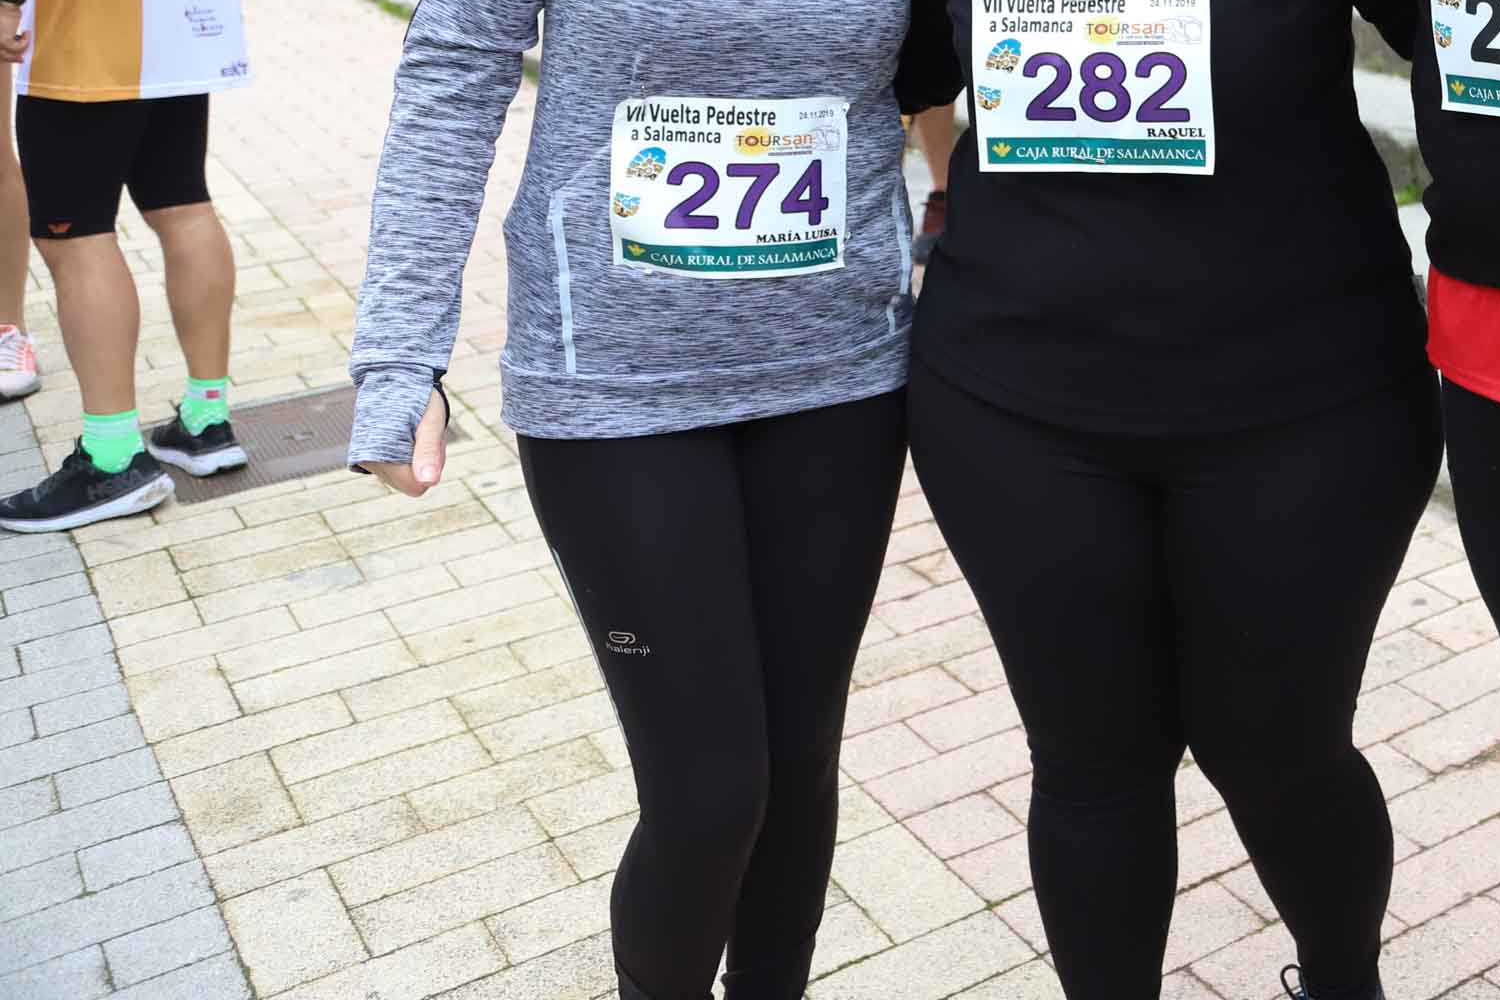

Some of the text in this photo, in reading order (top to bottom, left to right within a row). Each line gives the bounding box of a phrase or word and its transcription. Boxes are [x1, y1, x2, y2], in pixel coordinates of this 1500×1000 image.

[989, 17, 1073, 33] a Salamanca
[1022, 52, 1191, 123] 282
[1468, 86, 1494, 100] CAJA
[650, 103, 700, 125] Vuelta
[706, 105, 776, 127] Pedestre
[631, 126, 722, 144] a Salamanca
[1147, 128, 1206, 139] RAQUEL
[1016, 146, 1204, 161] CAJA RURAL DE SALAMANCA
[664, 159, 829, 230] 274
[756, 228, 838, 244] MARÍA LUISA
[650, 247, 837, 267] CAJA RURAL DE SALAMANCA
